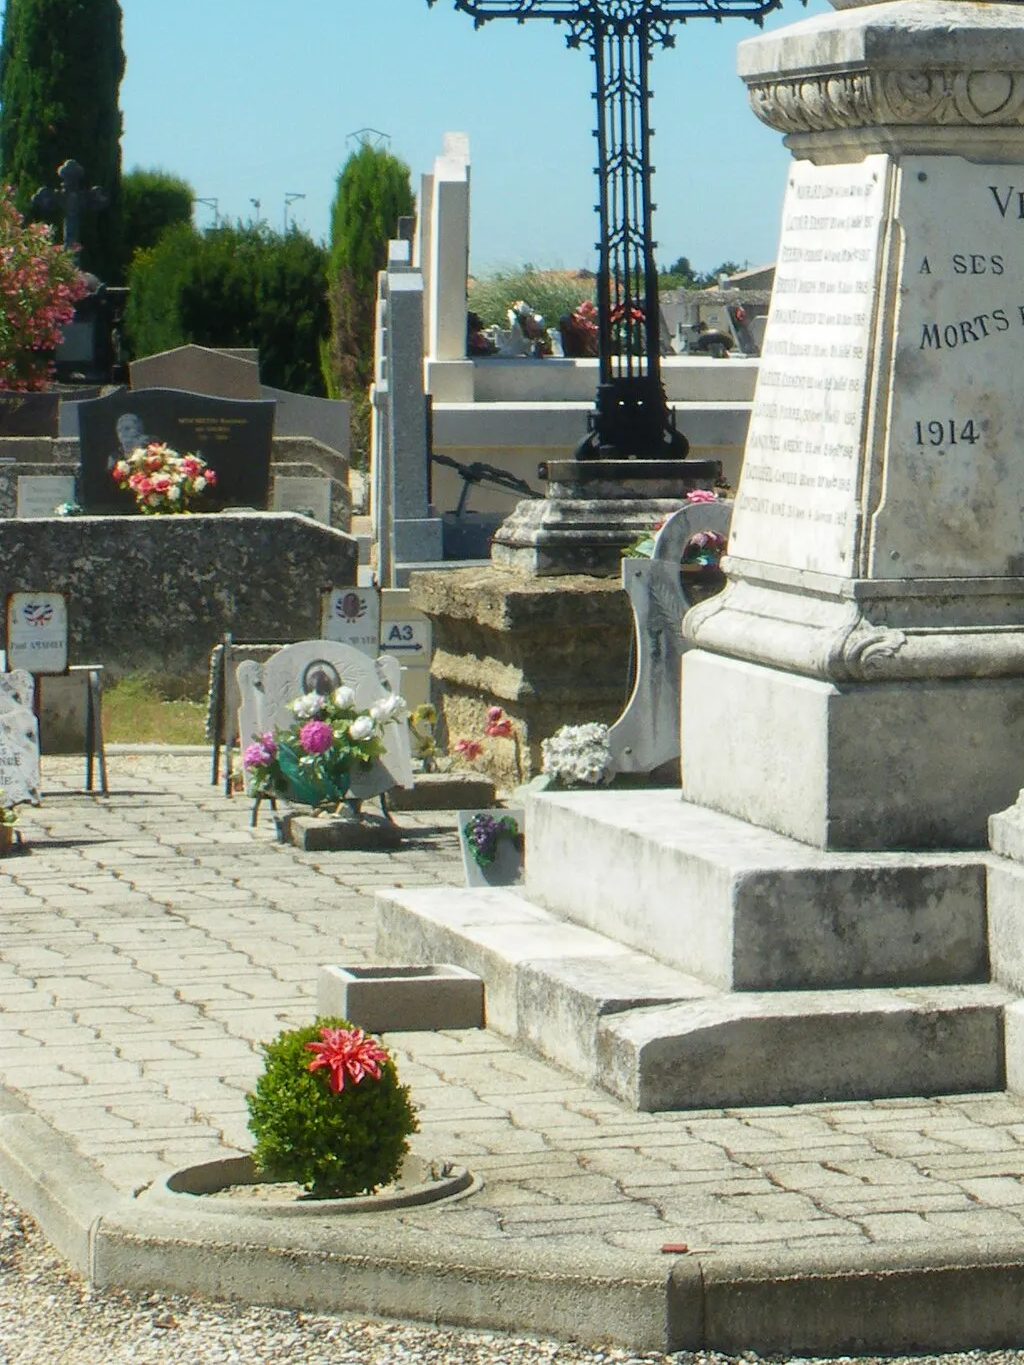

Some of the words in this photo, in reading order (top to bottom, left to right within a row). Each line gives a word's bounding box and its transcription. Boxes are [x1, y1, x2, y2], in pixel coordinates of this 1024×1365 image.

[919, 256, 932, 275] A
[953, 253, 1004, 275] SES
[919, 309, 1009, 350] MORTS
[914, 419, 980, 446] 1914
[388, 625, 414, 641] A3
